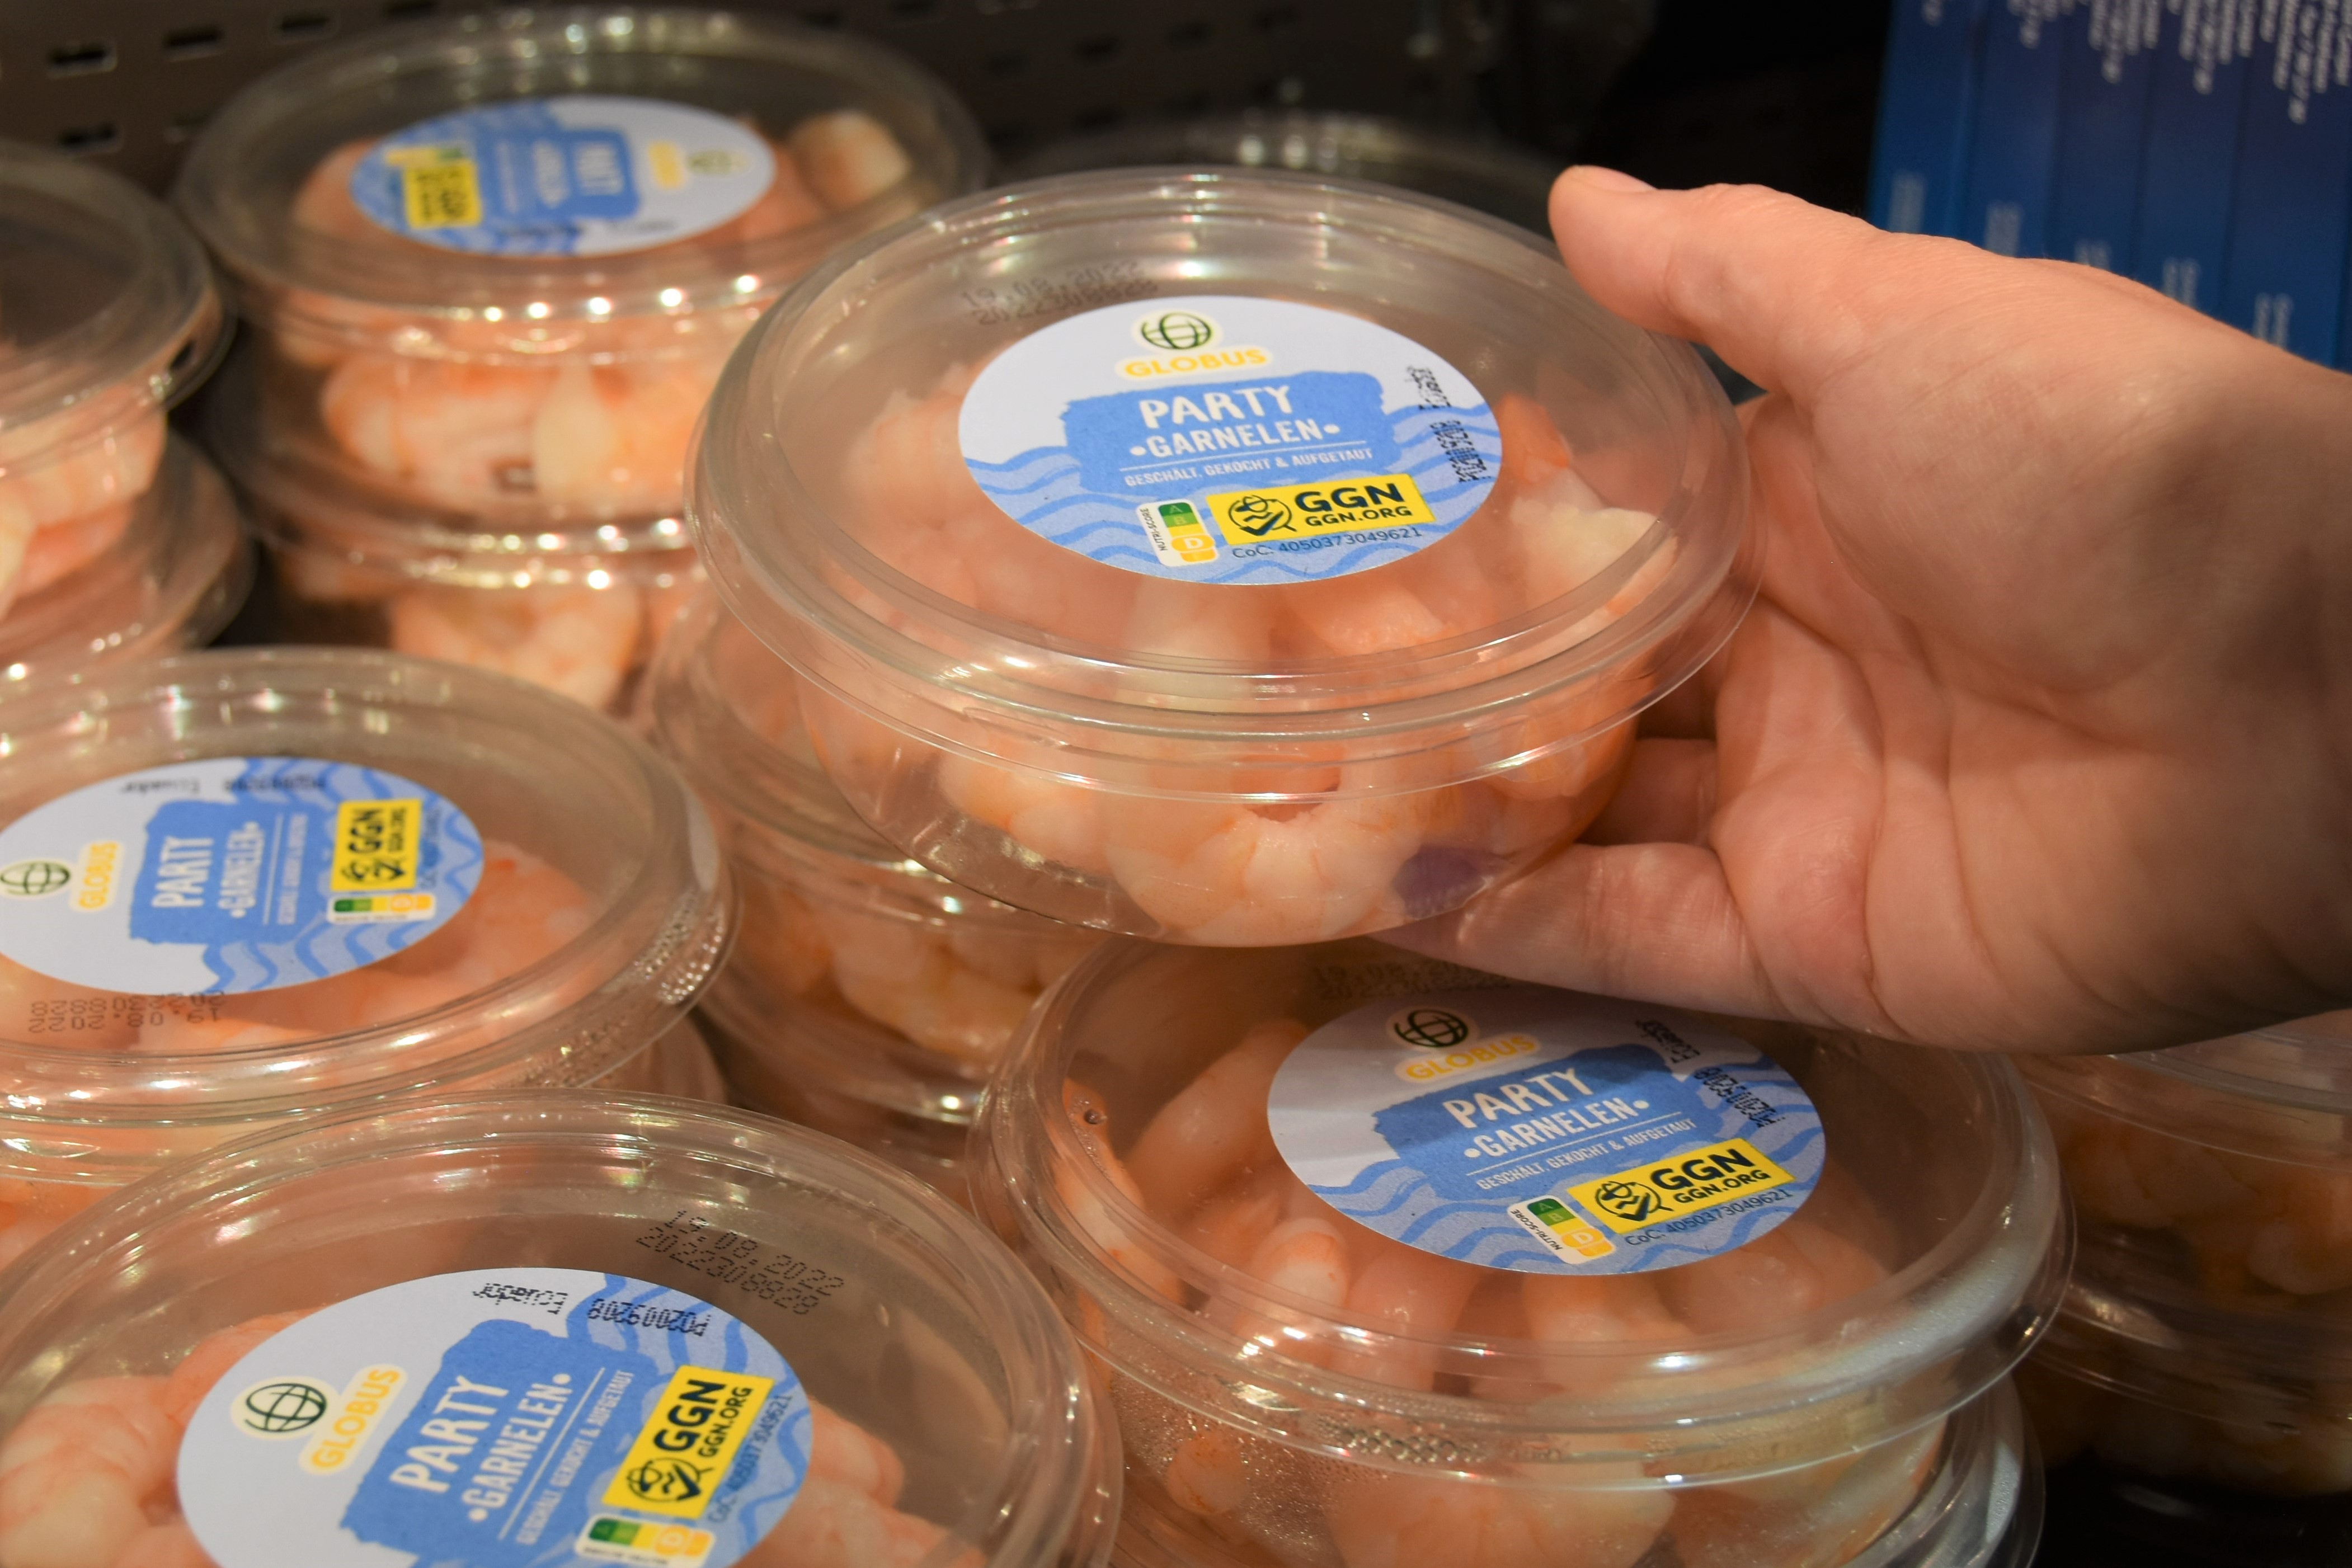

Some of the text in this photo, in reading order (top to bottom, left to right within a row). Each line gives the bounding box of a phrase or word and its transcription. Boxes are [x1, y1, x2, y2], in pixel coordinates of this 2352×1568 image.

[1125, 349, 1267, 376] GLOBUS
[1138, 384, 1293, 429] PARTY
[1204, 457, 1272, 477] GEKOCHT
[1276, 455, 1289, 468] &
[1292, 448, 1373, 467] AUFGETAUT
[1294, 483, 1405, 513] GGN
[1306, 506, 1412, 527] GGN.ORG
[1139, 507, 1169, 552] NUTRI-SCORE
[1184, 536, 1204, 549] D
[1279, 527, 1423, 553] 4050373049621
[78, 841, 119, 910] GLOBUS
[150, 835, 214, 908] PARTY
[28, 1006, 222, 1034] 19.08.2022
[1406, 1036, 1537, 1080] GLOBUS
[1442, 1068, 1593, 1128] PARTY
[1546, 1143, 1609, 1171] GEKOCHT
[1609, 1139, 1624, 1152] &
[1623, 1118, 1697, 1147] AUFGETAUT
[1650, 1148, 1756, 1190] GGN
[1673, 1169, 1771, 1204] GGN.ORG
[1511, 1209, 1563, 1250] NUTRI-SCORE
[1574, 1230, 1595, 1244] D
[1624, 1188, 1794, 1246] CoC: 4050373049621
[636, 1226, 820, 1315] 2022308828
[664, 1210, 844, 1297] 19.08.2022
[311, 1368, 401, 1469] GLOBUS
[389, 1374, 509, 1494] PARTY
[653, 1378, 727, 1452] GGN
[697, 1386, 754, 1458] GGN.ORG
